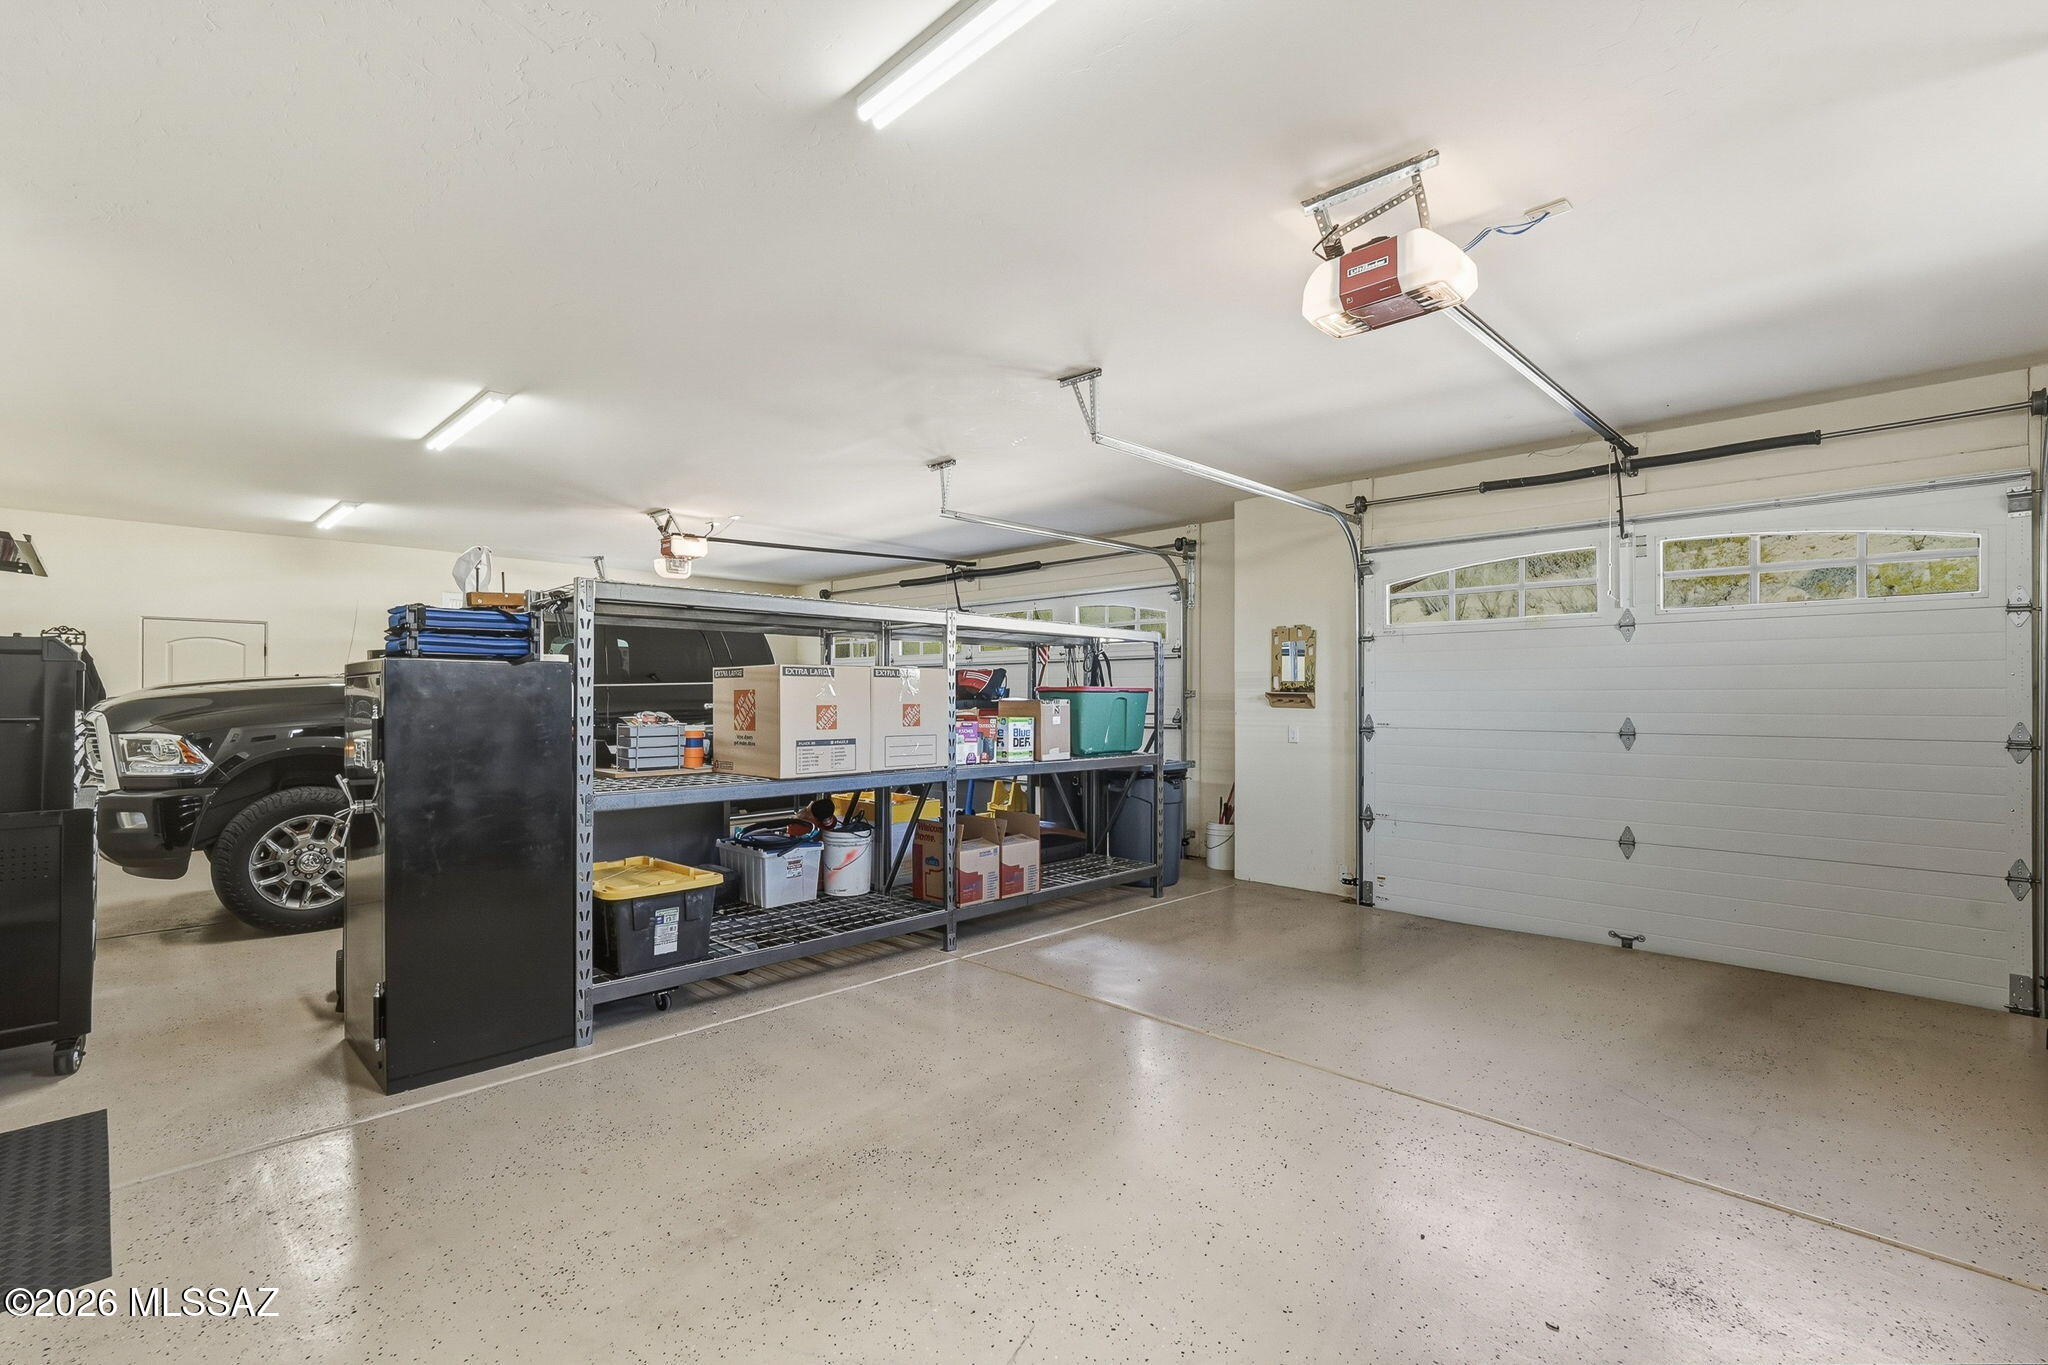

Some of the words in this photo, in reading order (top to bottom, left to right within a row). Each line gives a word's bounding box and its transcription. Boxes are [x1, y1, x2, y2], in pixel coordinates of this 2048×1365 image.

[785, 667, 808, 676] EXTRA
[1013, 728, 1031, 737] Blue
[1013, 737, 1031, 747] DEF
[918, 822, 943, 834] Welcom
